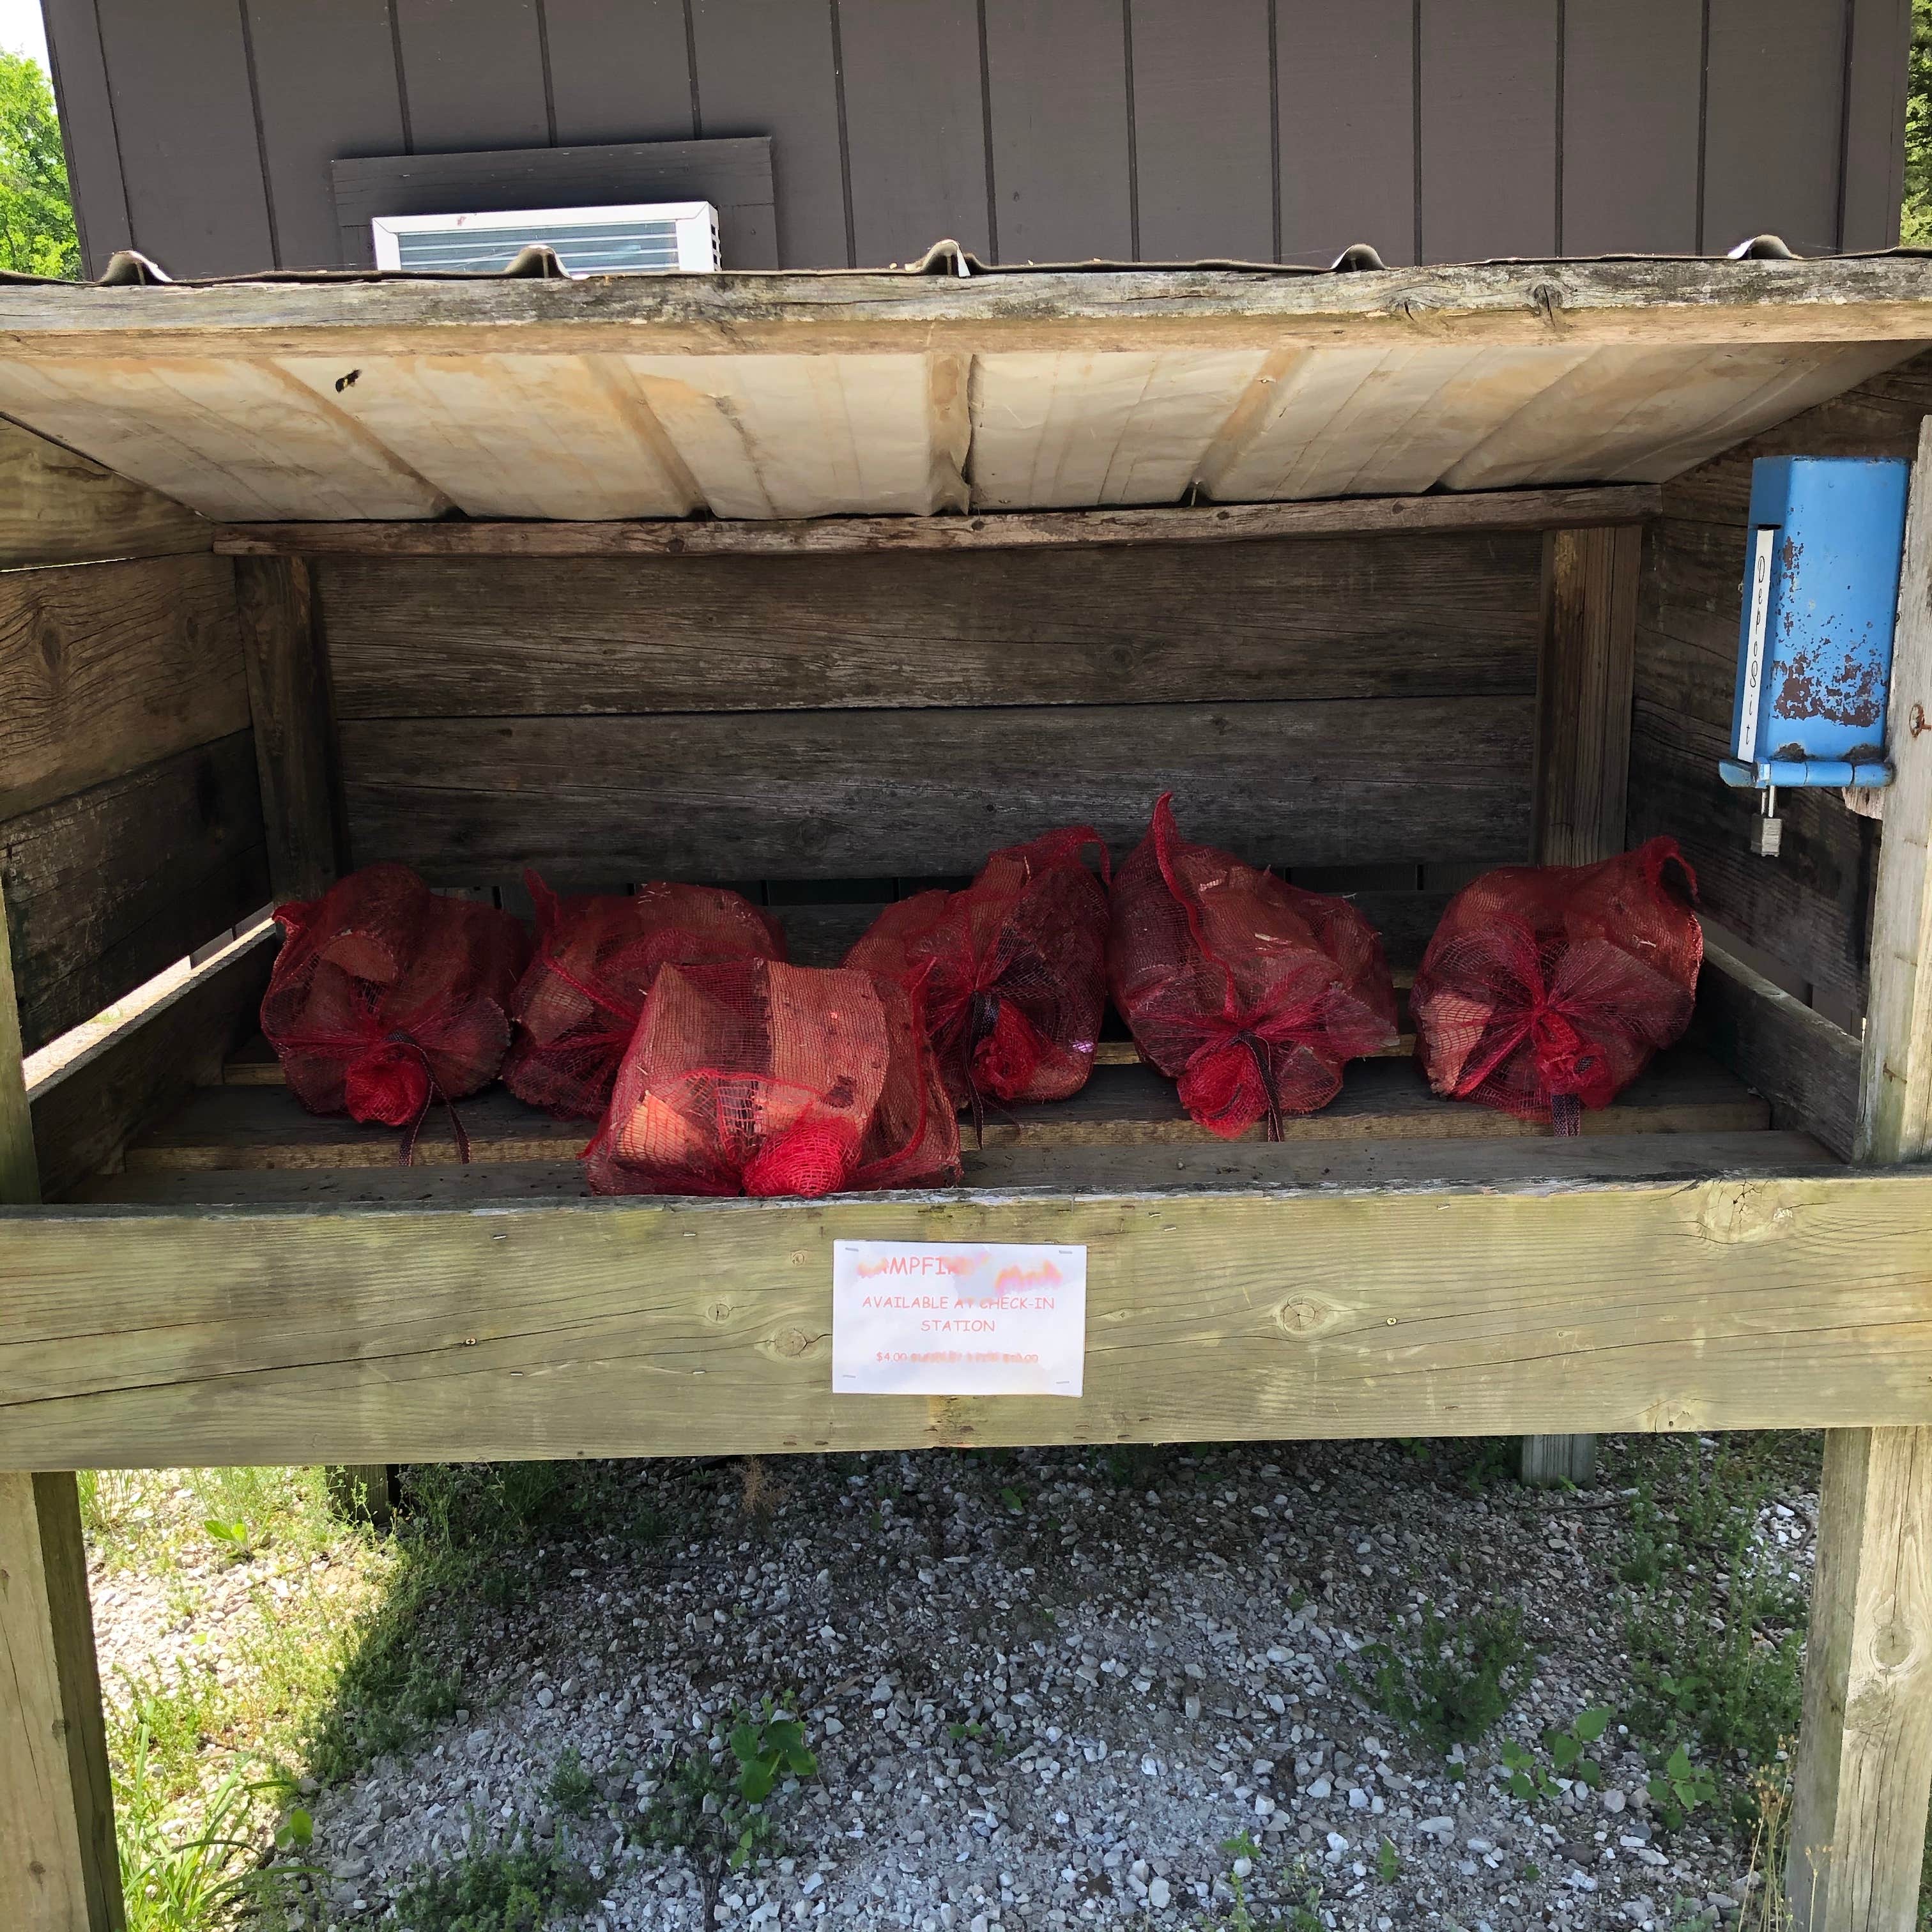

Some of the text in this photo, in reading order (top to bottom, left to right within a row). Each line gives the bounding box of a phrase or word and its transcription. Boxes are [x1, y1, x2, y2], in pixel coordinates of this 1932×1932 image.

[862, 1296, 949, 1309] AVAILABLE
[979, 1296, 1055, 1310] CHECK-IN
[920, 1319, 995, 1332] STATION
[876, 1351, 908, 1363] $4.00
